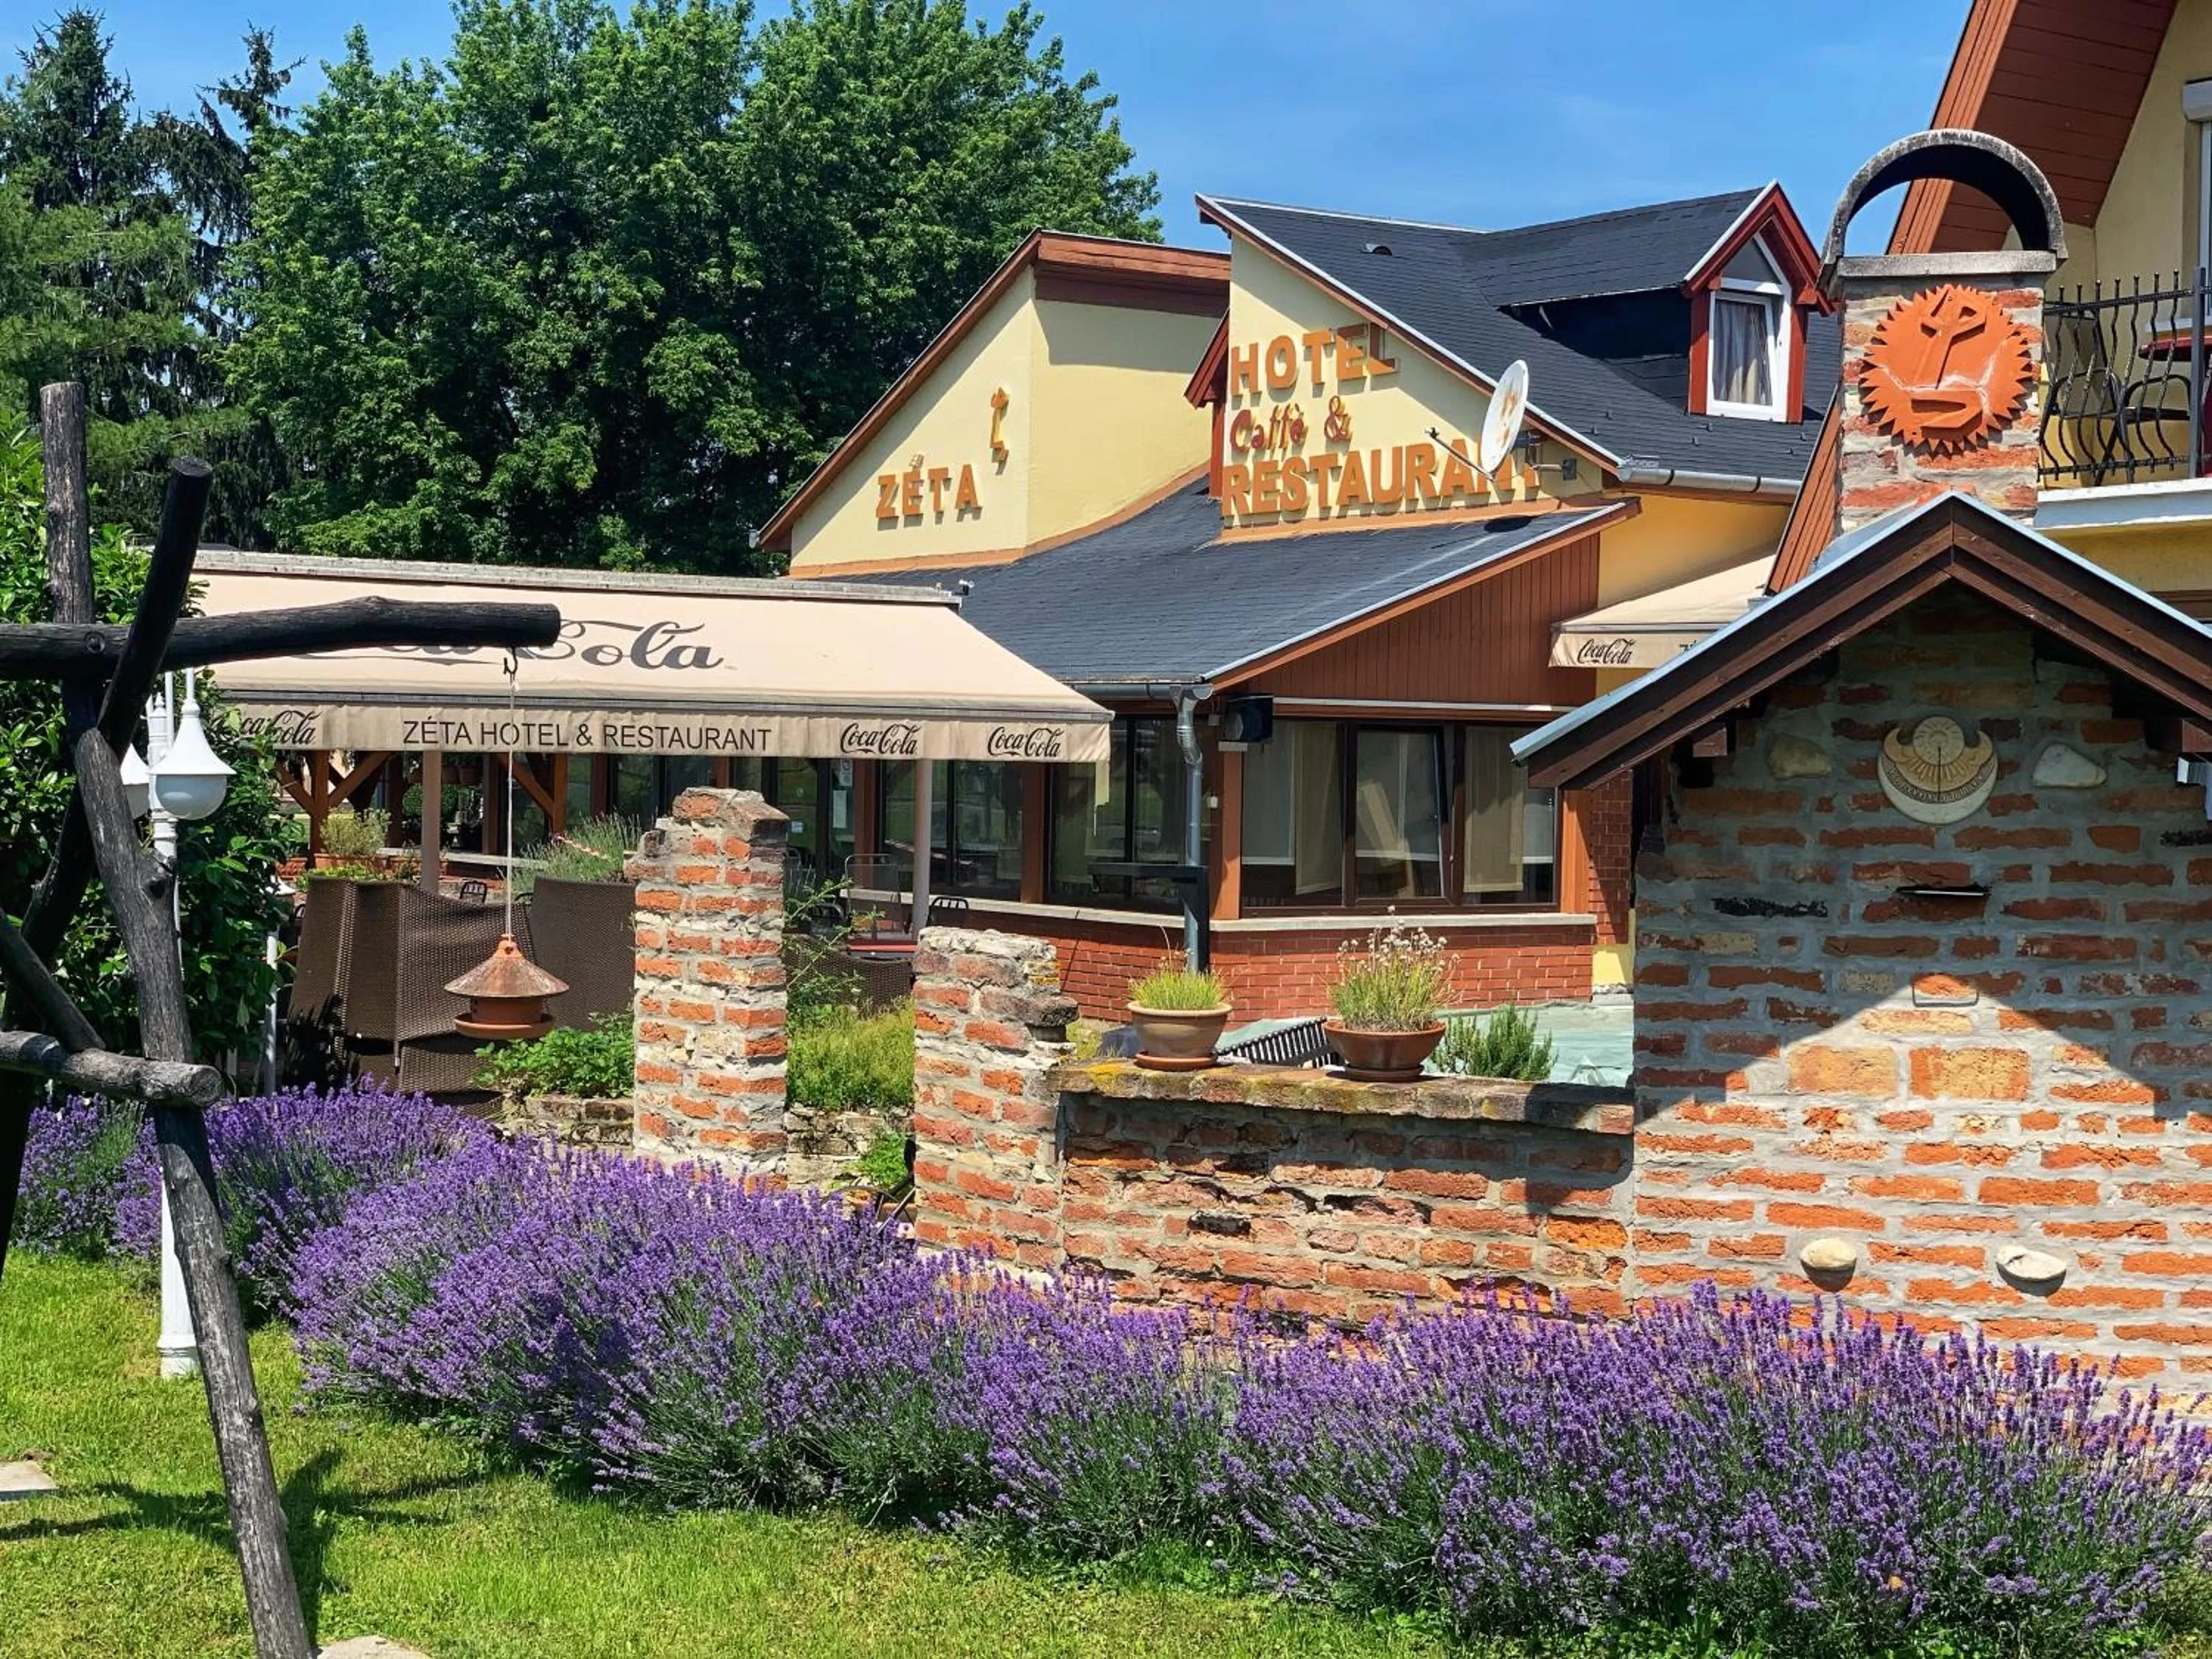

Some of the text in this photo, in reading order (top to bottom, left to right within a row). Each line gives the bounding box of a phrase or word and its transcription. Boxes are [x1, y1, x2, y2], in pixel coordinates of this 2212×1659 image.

[1231, 323, 1395, 395] HOTEL
[1324, 395, 1352, 443] &
[876, 453, 978, 518] ZÉTA
[403, 715, 772, 751] ZÉTA HOTEL & RESTAURANT
